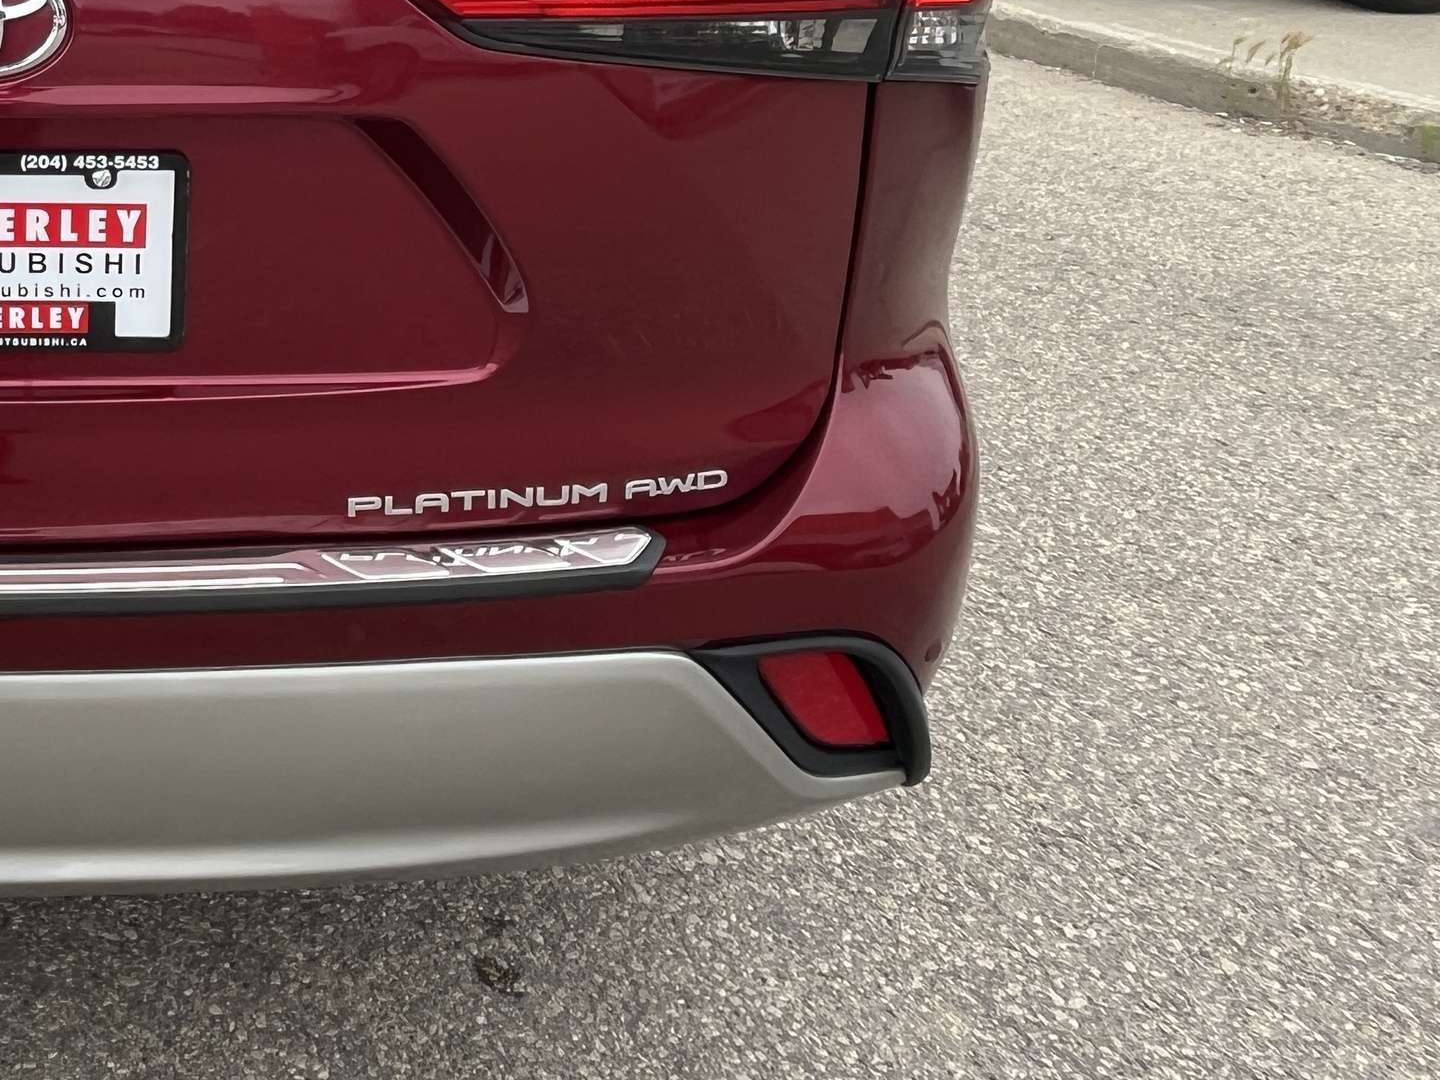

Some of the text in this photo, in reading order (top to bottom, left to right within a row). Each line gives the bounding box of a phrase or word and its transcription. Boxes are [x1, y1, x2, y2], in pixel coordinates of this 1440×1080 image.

[20, 155, 160, 170] (204) 453-5453
[346, 469, 729, 518] PLATINUM AWD
